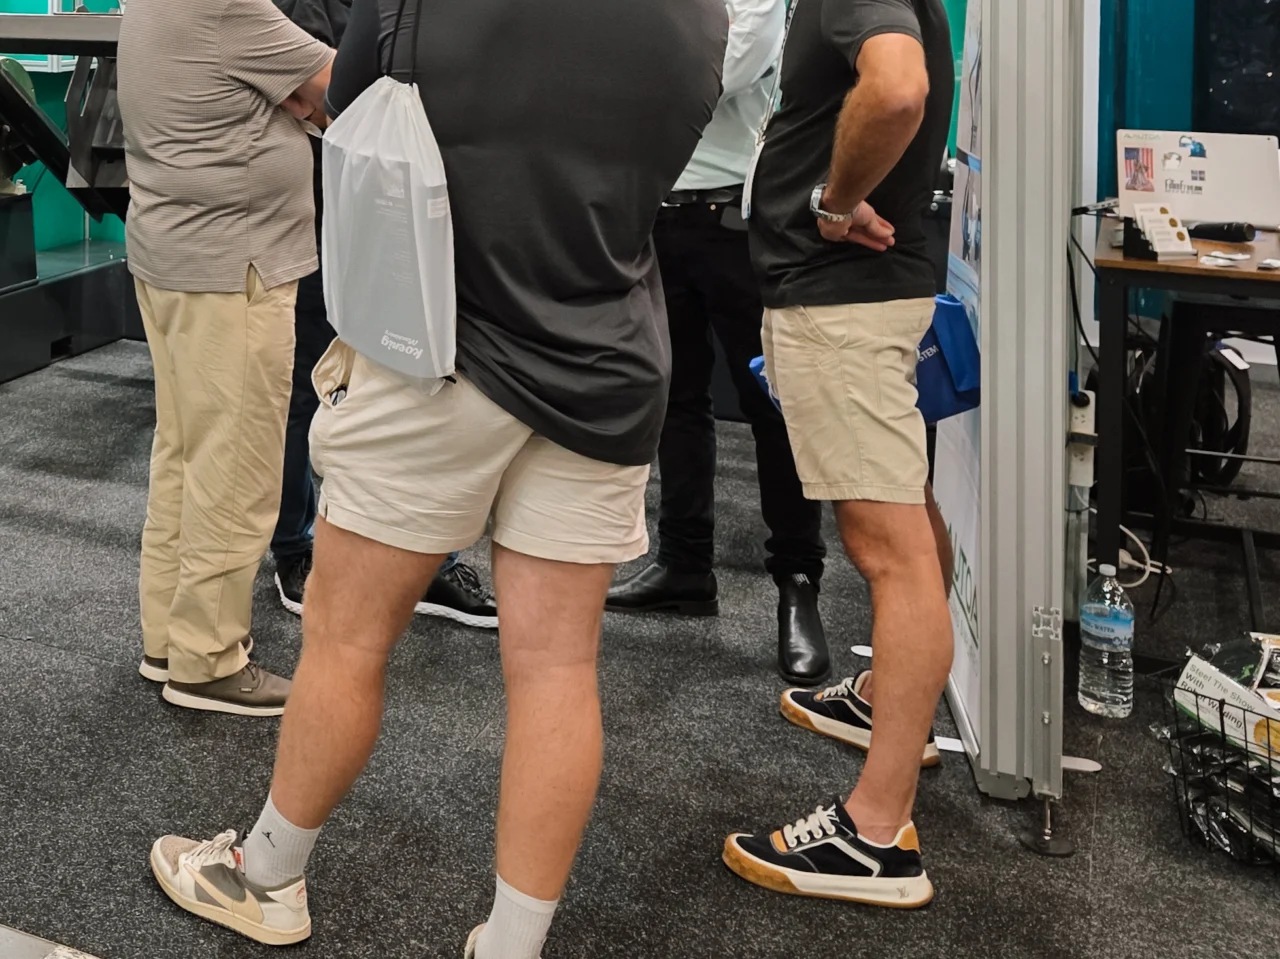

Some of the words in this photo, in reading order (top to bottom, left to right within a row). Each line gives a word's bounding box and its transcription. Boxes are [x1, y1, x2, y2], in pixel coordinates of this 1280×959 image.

[1185, 672, 1204, 690] With
[1189, 664, 1213, 682] Steel
[1213, 679, 1229, 694] The
[1230, 691, 1256, 712] Show
[1207, 698, 1245, 729] Weding.
